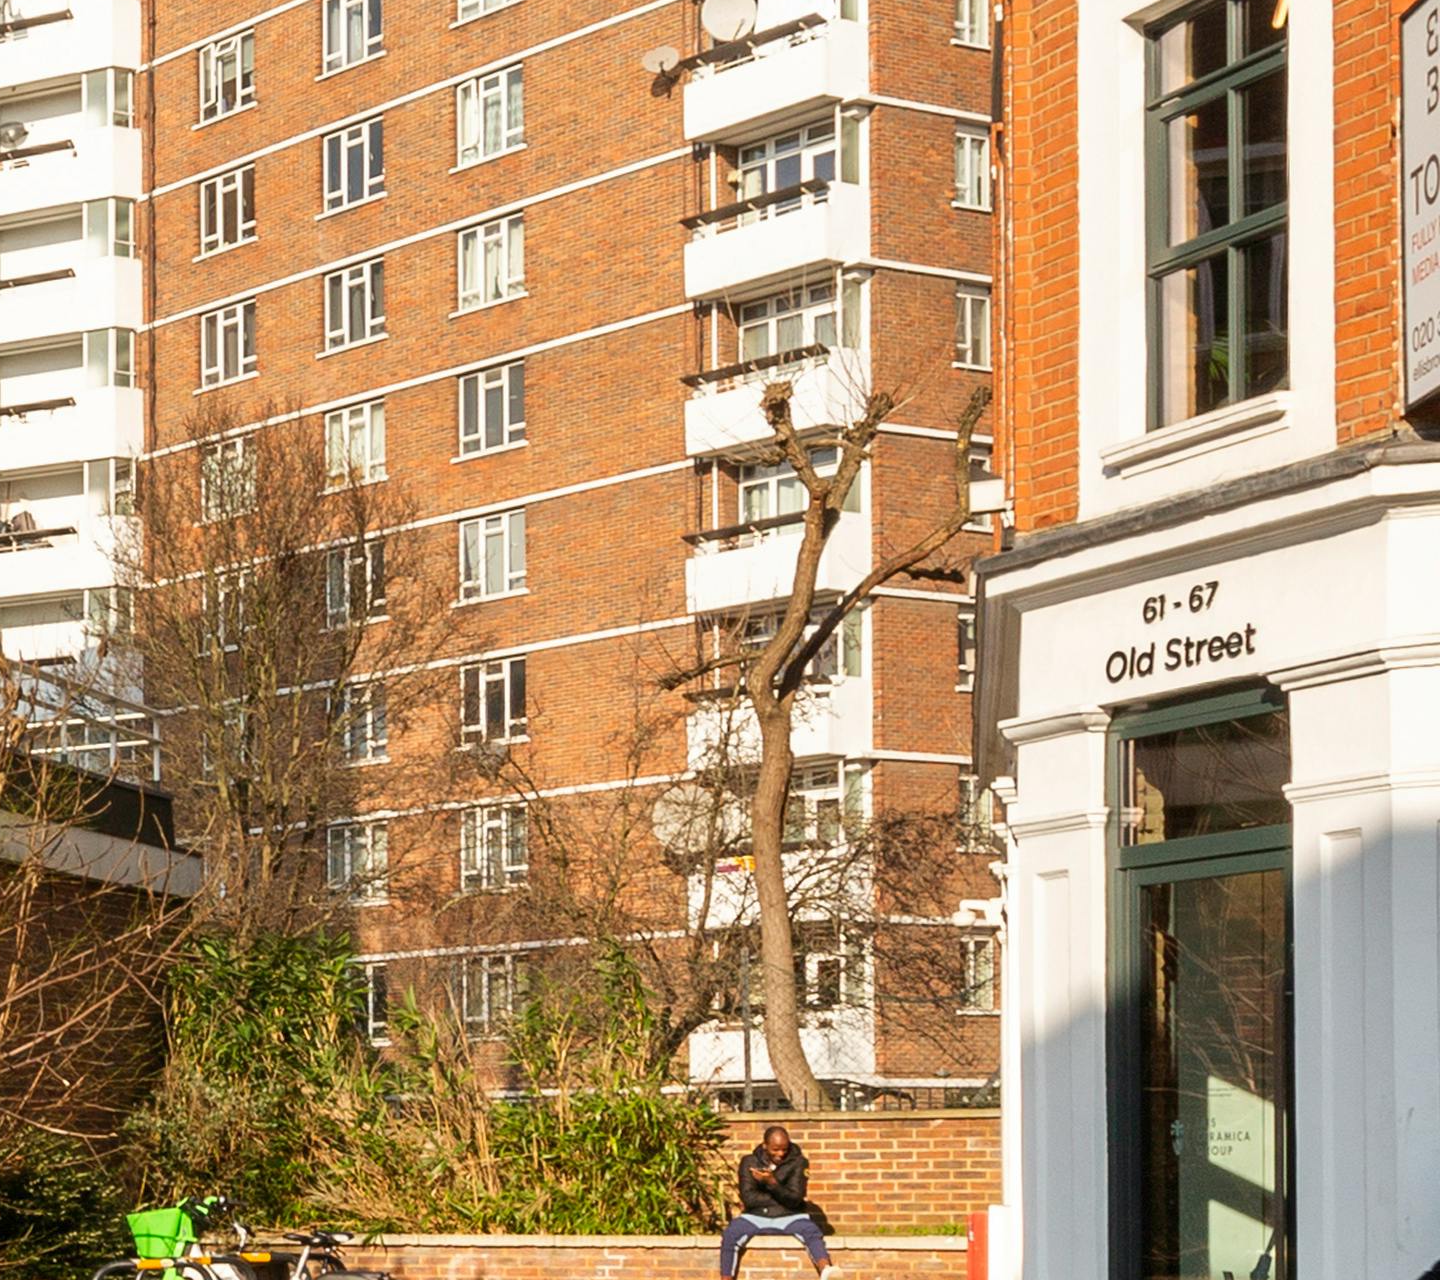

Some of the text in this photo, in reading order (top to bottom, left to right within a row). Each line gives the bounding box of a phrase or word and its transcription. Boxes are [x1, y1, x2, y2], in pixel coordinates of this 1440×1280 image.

[1412, 317, 1435, 353] 020
[1143, 594, 1166, 624] 61
[1189, 580, 1219, 613] 67
[1106, 623, 1257, 684] Old Street
